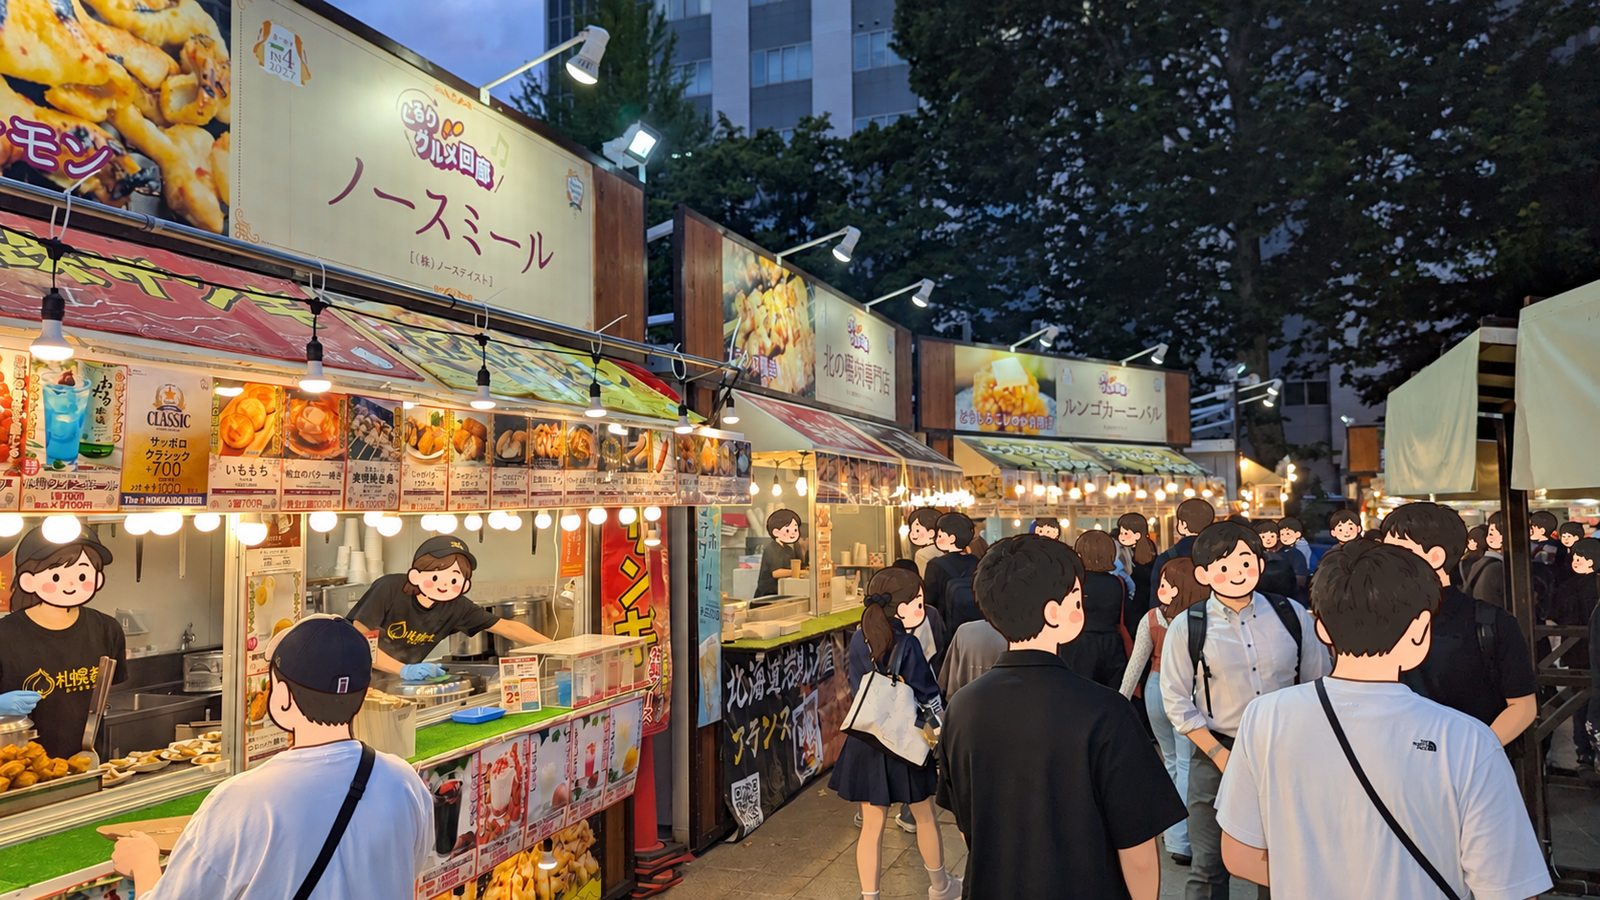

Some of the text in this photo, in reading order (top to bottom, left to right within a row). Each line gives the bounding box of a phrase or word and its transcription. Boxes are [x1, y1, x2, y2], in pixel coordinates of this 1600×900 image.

[0, 115, 112, 178] モン
[415, 129, 493, 187] グルメ回廊
[328, 156, 553, 274] ノースミール
[147, 409, 192, 429] CLASSIC
[1062, 398, 1163, 425] ルンゴカーニバル
[150, 436, 188, 449] サッポロ
[145, 449, 191, 462] クラシック
[226, 464, 269, 478] いももち
[145, 495, 183, 505] HOKKAIDO
[731, 705, 792, 766] フランス
